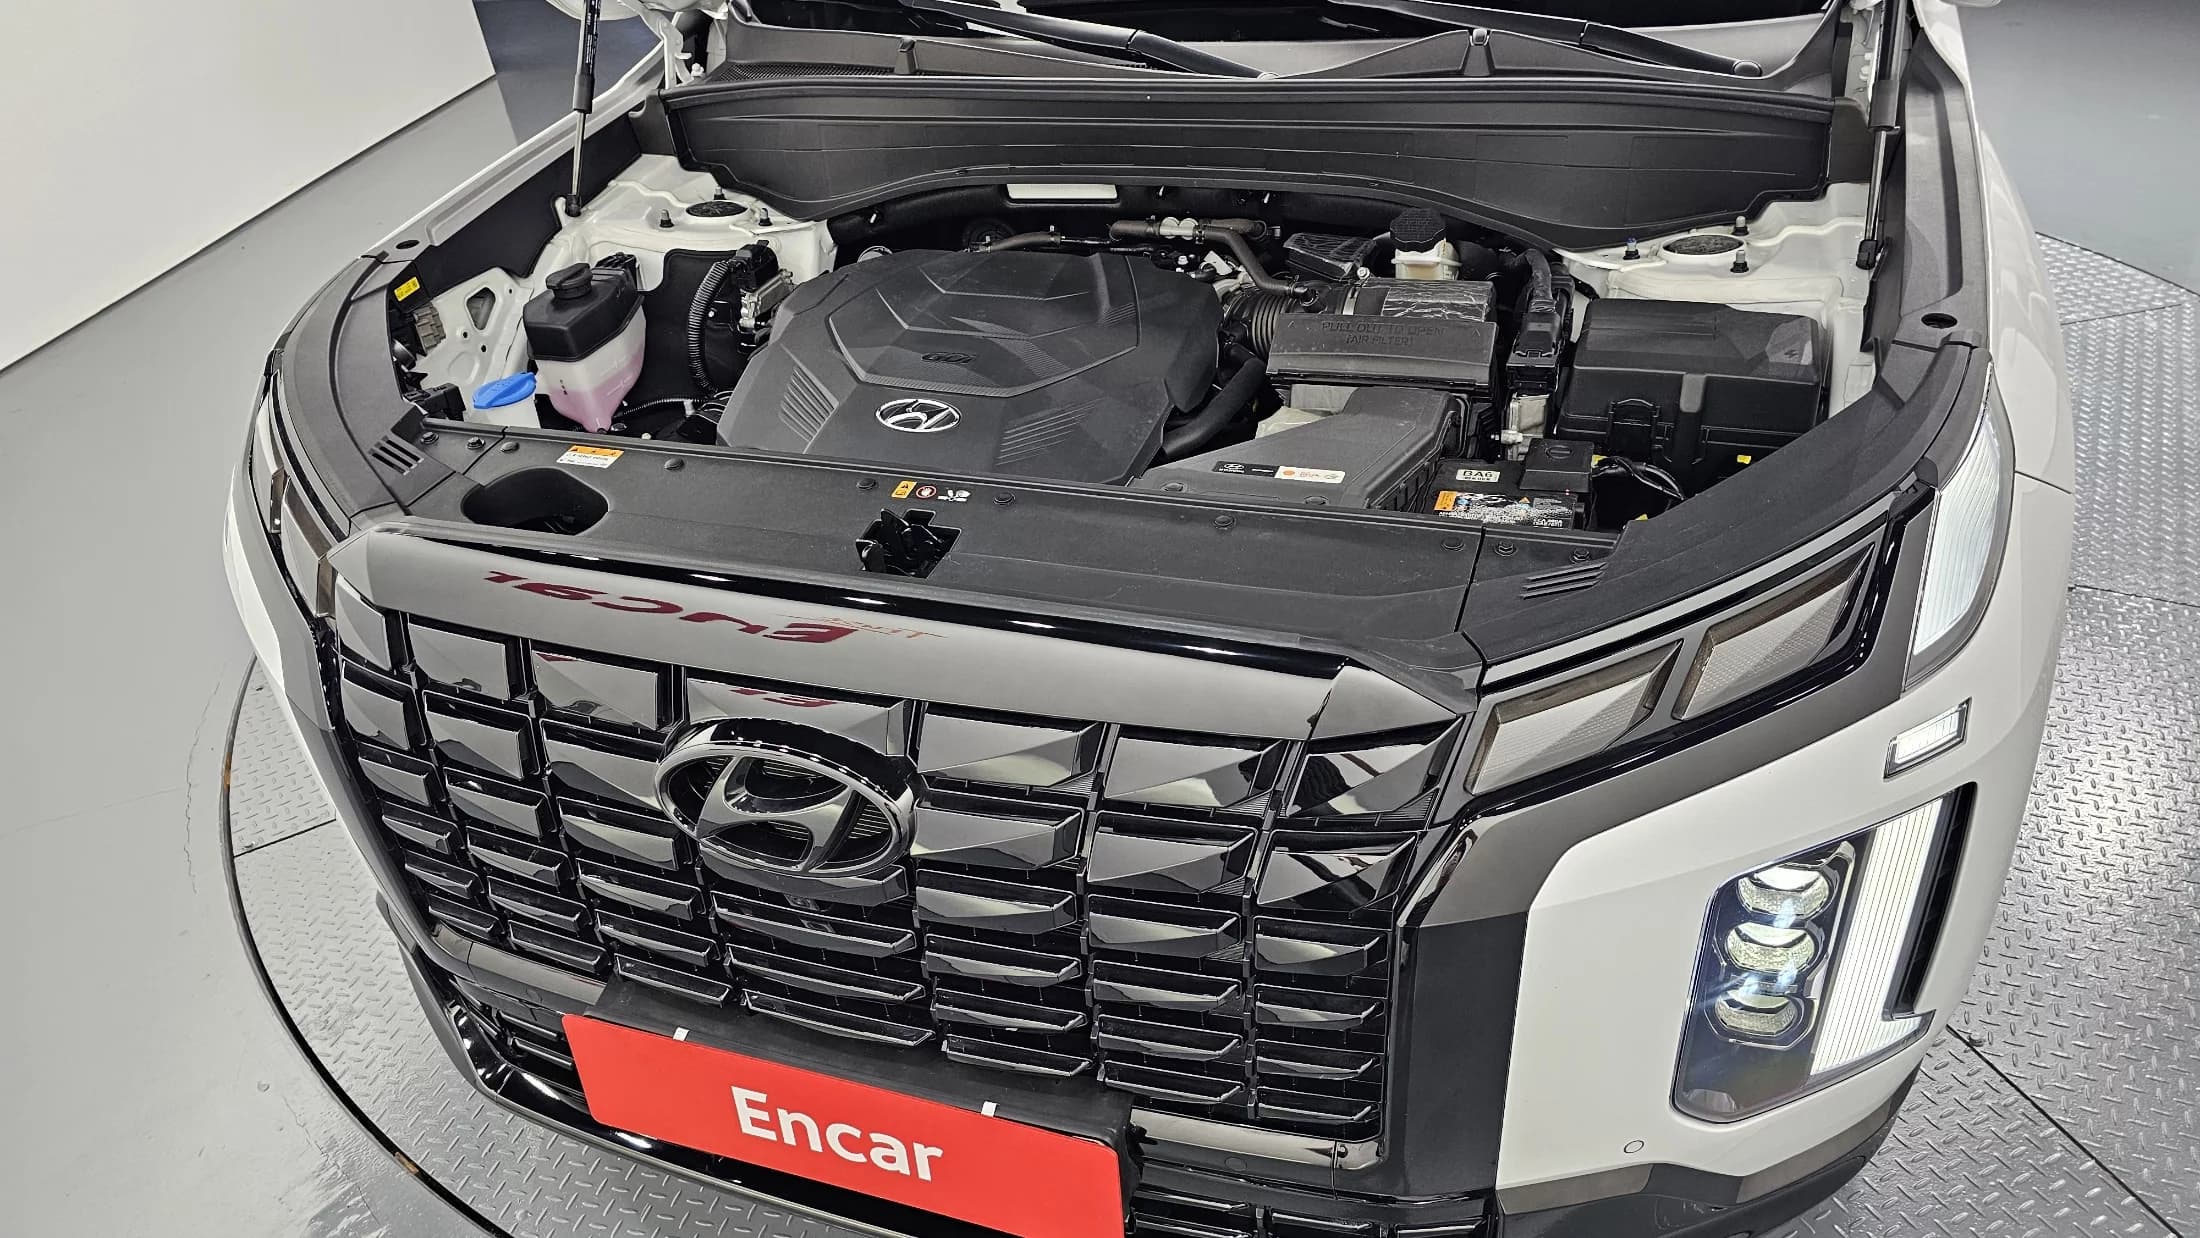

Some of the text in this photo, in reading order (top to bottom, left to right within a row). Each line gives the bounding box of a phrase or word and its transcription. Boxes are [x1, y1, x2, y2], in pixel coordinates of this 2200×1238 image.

[1322, 321, 1447, 337] PULL OUT TO OPEN
[730, 1085, 944, 1183] Encar
